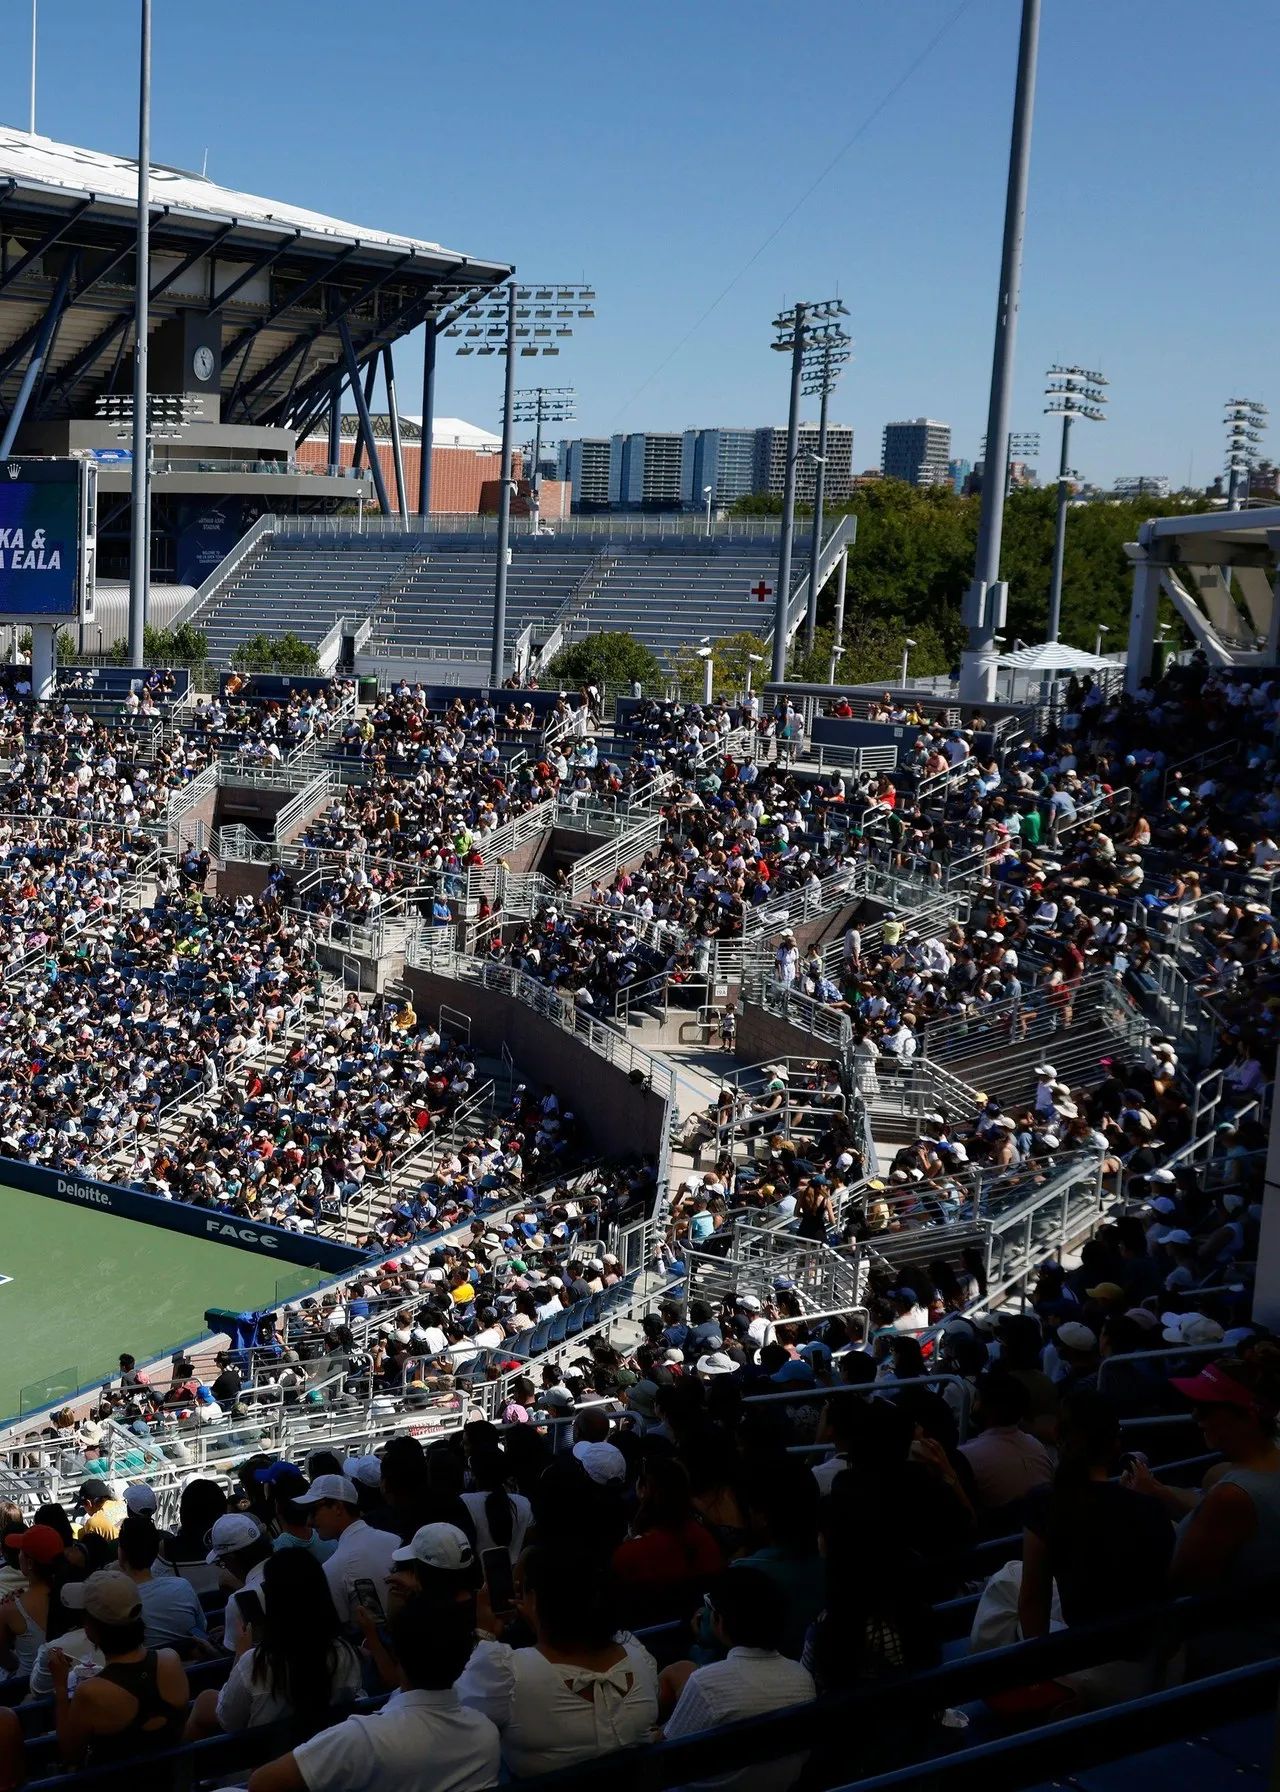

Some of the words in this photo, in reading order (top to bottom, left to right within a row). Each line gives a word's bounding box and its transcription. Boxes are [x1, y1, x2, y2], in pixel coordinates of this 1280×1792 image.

[31, 528, 46, 549] &
[11, 550, 61, 570] EALA
[57, 1179, 113, 1205] Deloitte.
[206, 1220, 279, 1249] FAGE
